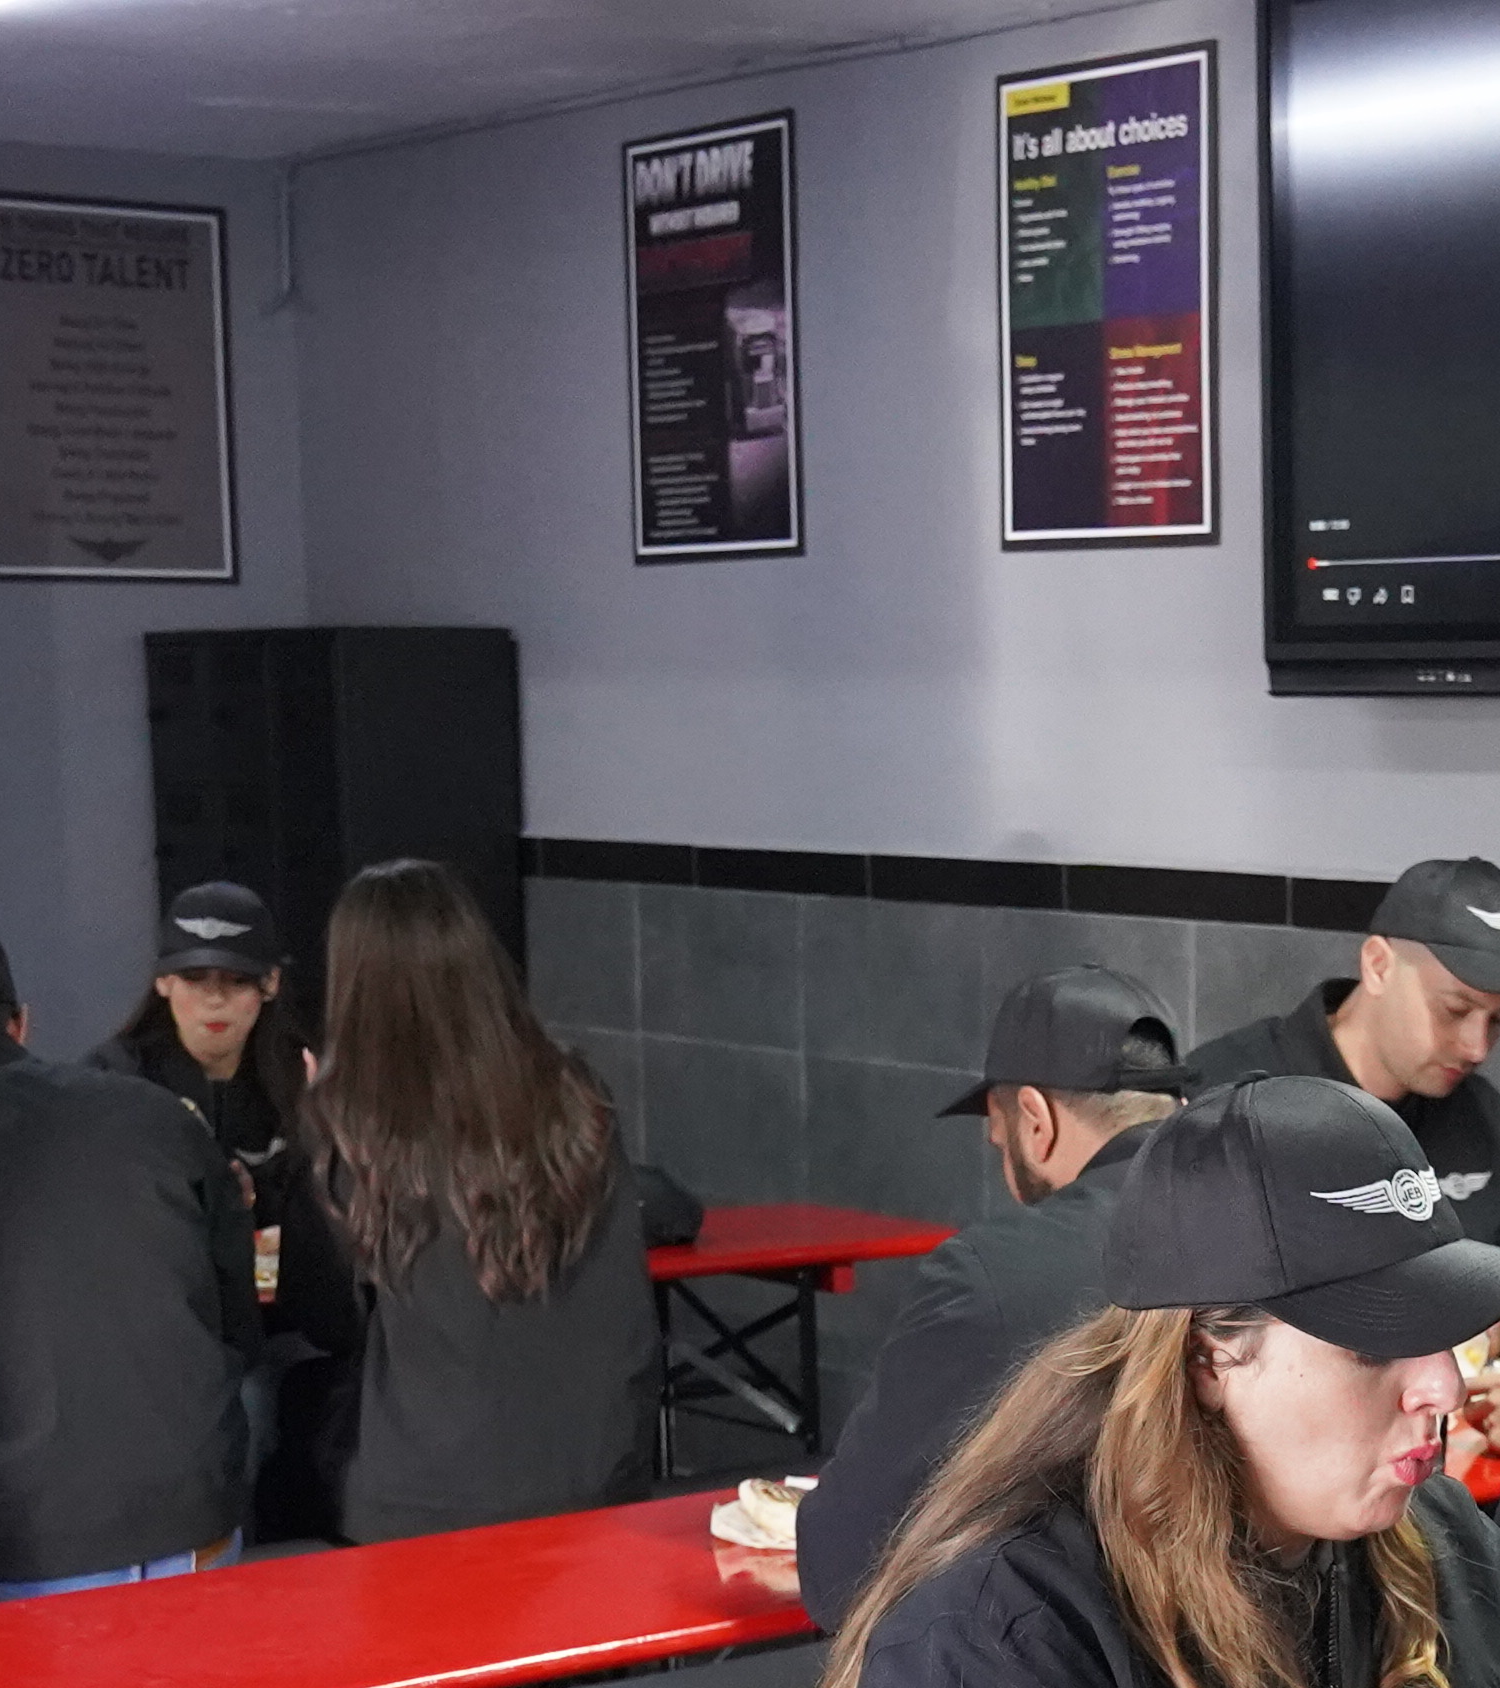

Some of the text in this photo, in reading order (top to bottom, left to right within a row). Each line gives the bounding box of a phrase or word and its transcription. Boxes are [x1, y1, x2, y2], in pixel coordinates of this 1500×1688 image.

[1013, 113, 1189, 161] It's all about choices
[81, 250, 191, 292] TALENT
[1402, 1186, 1423, 1203] JEB
